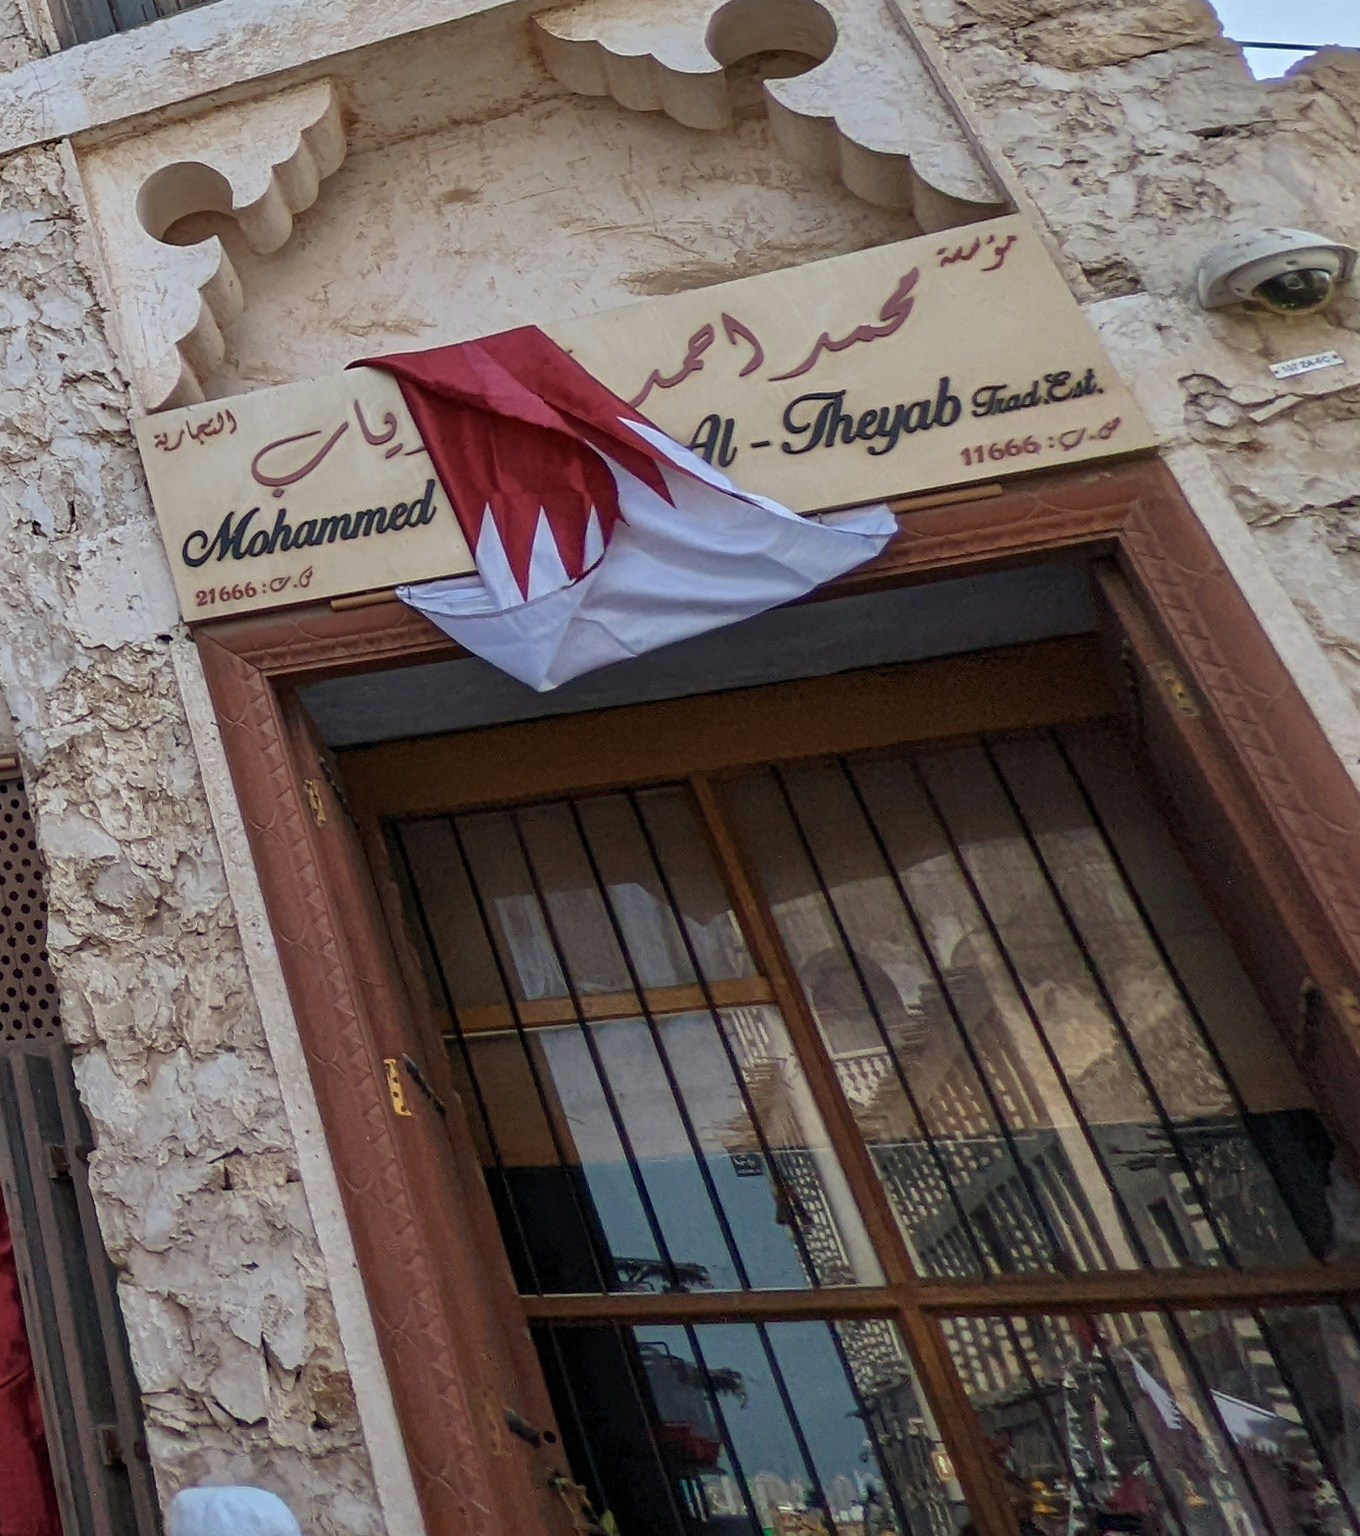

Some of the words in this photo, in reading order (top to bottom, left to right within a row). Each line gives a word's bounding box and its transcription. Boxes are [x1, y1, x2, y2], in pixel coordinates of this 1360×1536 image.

[768, 266, 920, 383] محمد
[154, 409, 237, 451] التجارية
[960, 435, 1043, 466] 11666
[181, 479, 437, 568] Mohammed
[196, 581, 257, 607] 21666
